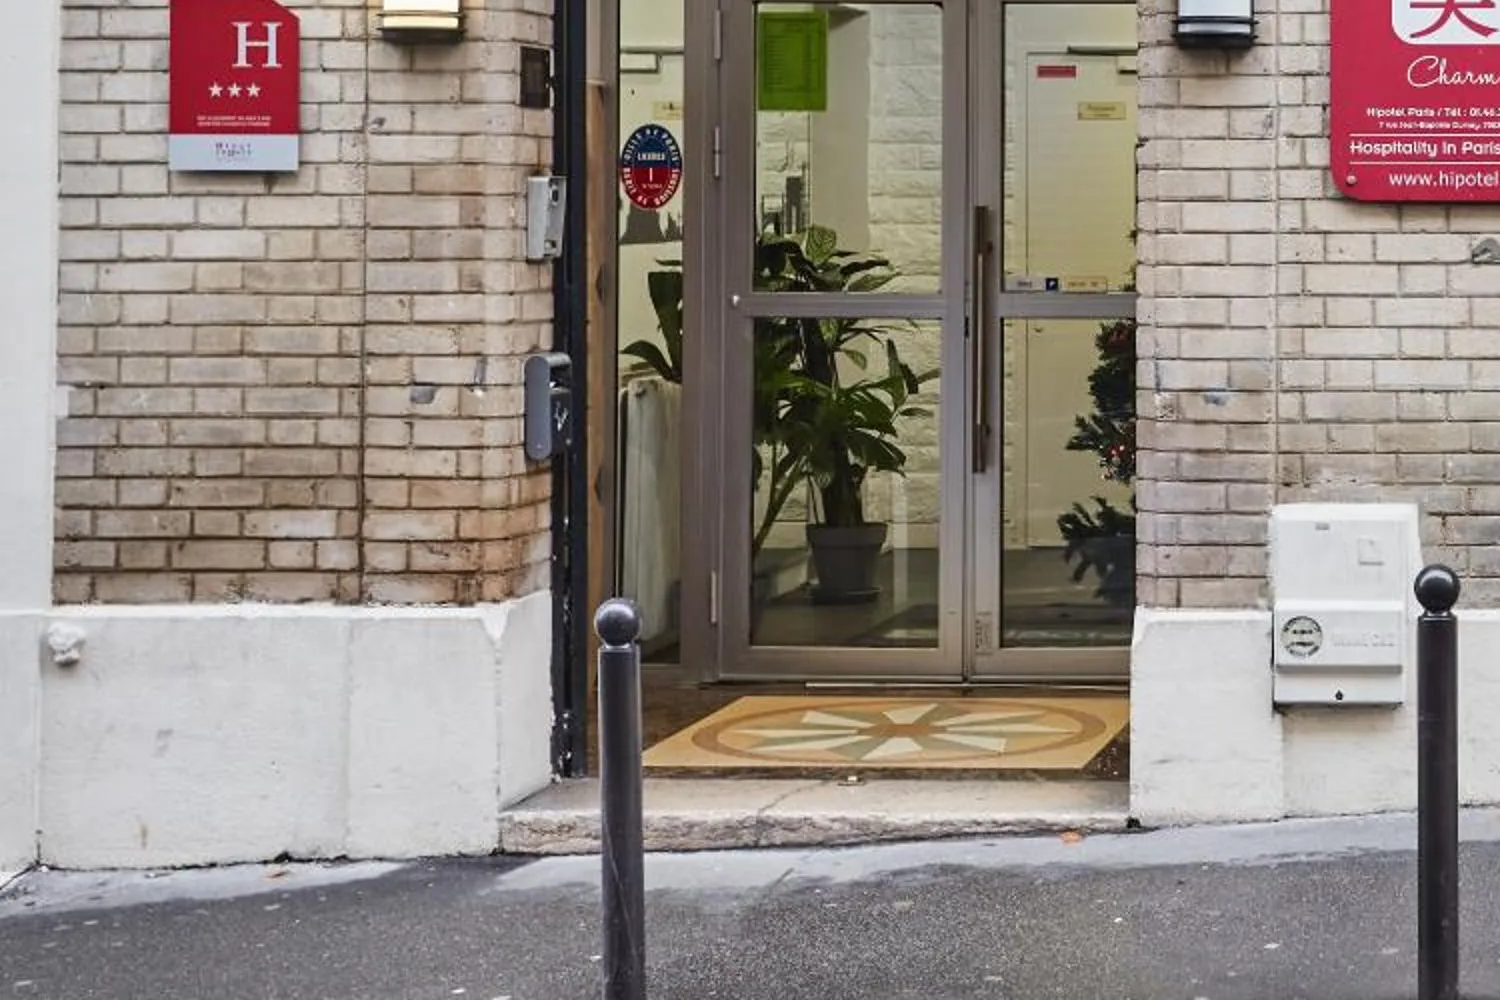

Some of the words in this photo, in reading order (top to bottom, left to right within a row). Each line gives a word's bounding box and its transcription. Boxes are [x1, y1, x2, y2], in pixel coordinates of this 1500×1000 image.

[230, 21, 284, 69] H
[1407, 106, 1435, 117] Paris
[1350, 141, 1438, 157] Hospitality
